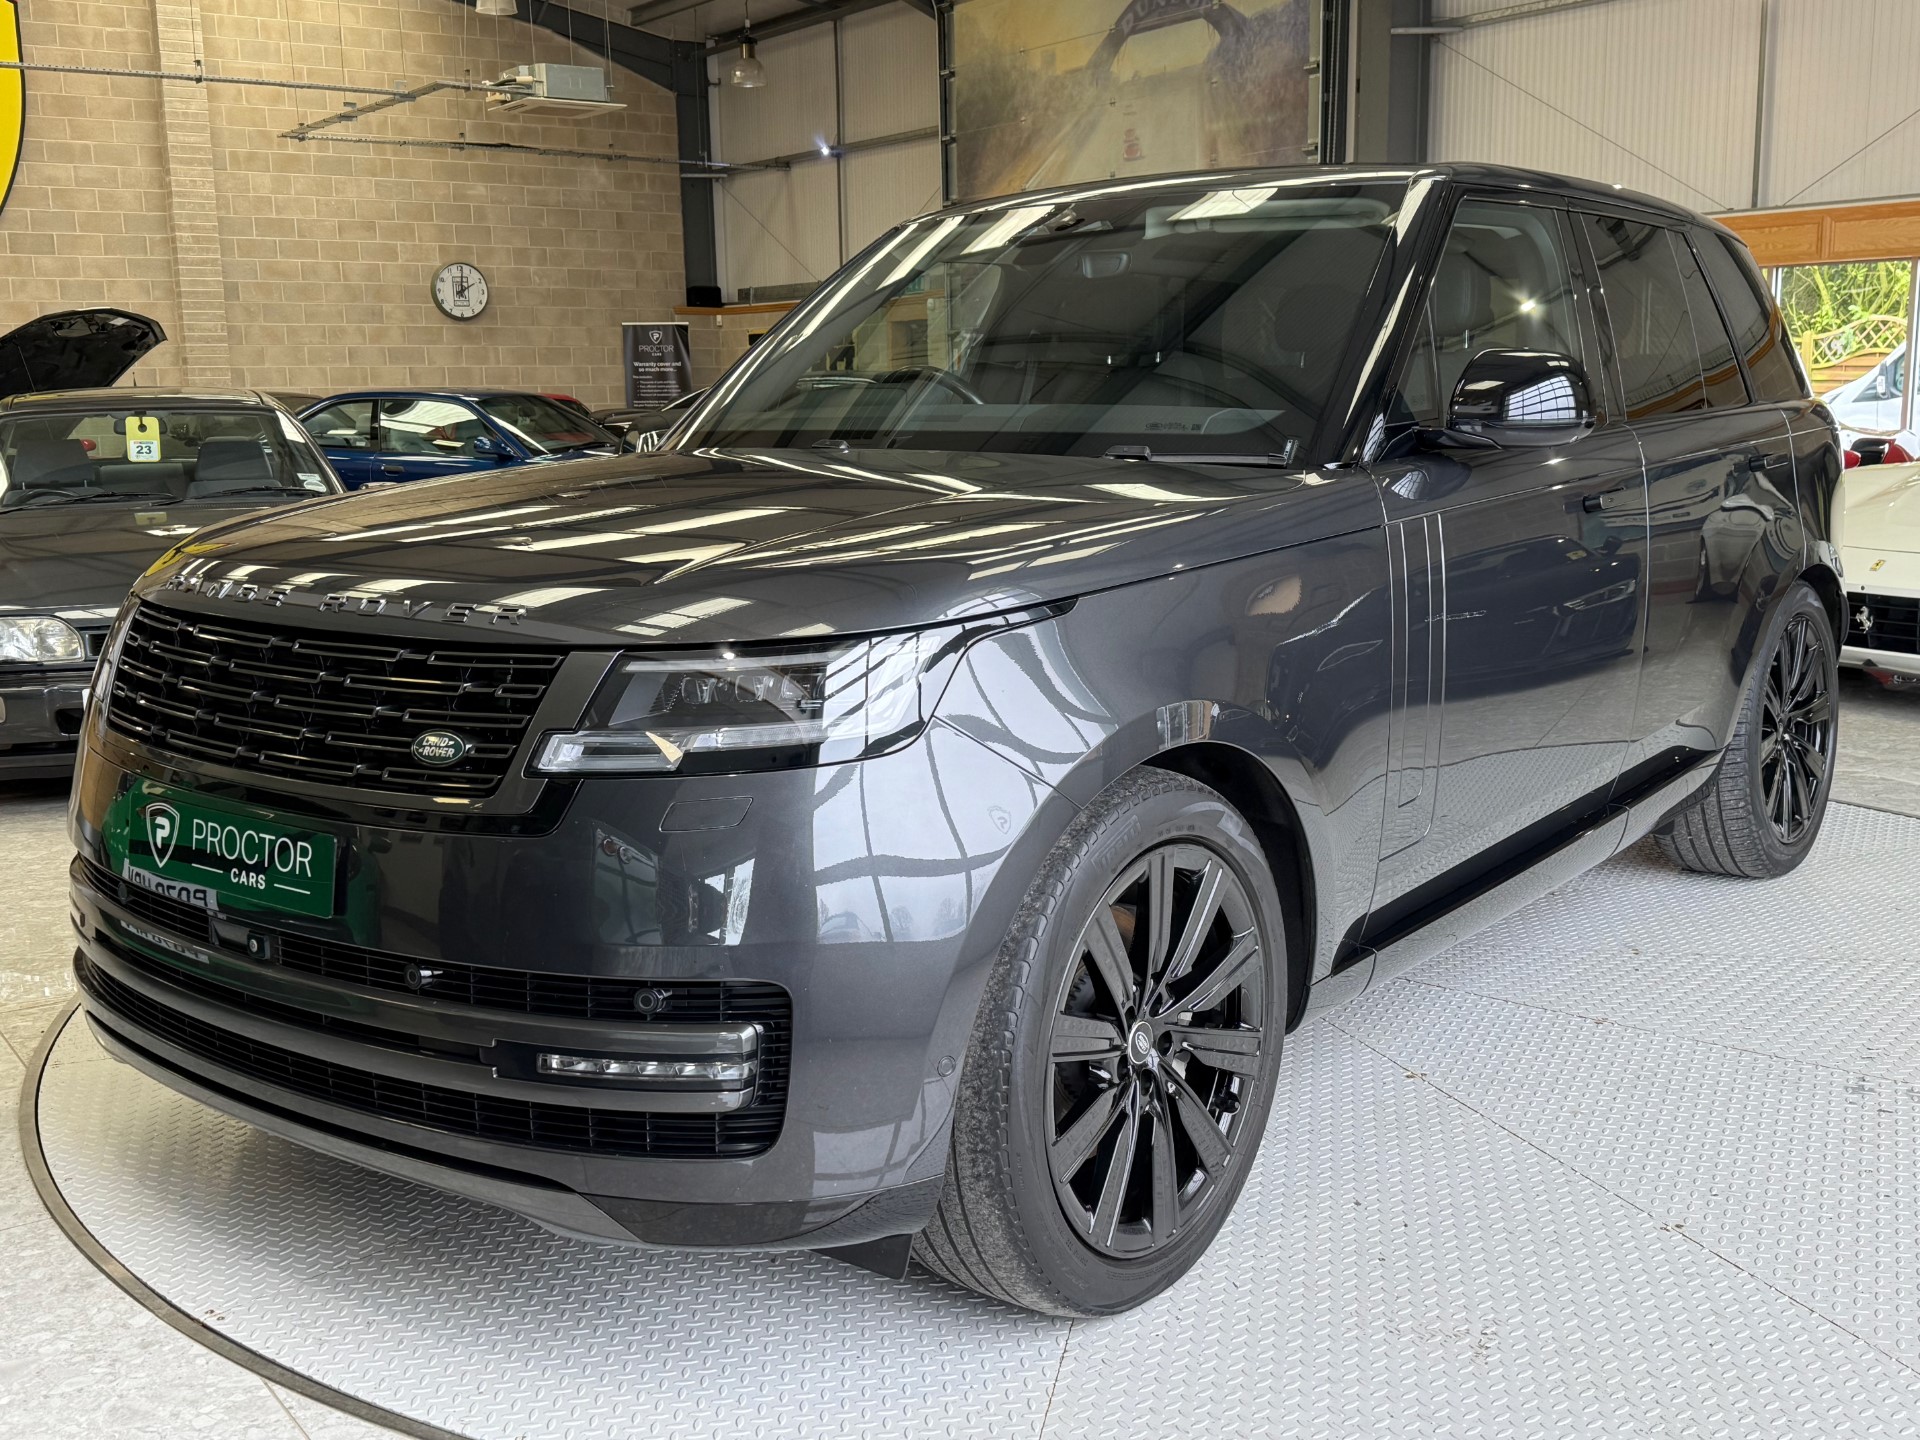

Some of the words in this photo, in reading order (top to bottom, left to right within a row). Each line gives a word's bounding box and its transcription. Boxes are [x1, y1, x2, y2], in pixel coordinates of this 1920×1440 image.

[638, 345, 674, 353] PROCTOR
[136, 445, 152, 455] 23
[165, 573, 291, 607] RANGE
[317, 592, 527, 626] ROVER
[422, 736, 449, 747] LAND
[422, 746, 455, 758] ROVER
[191, 817, 313, 878] PROCTOR
[229, 867, 267, 890] CARS
